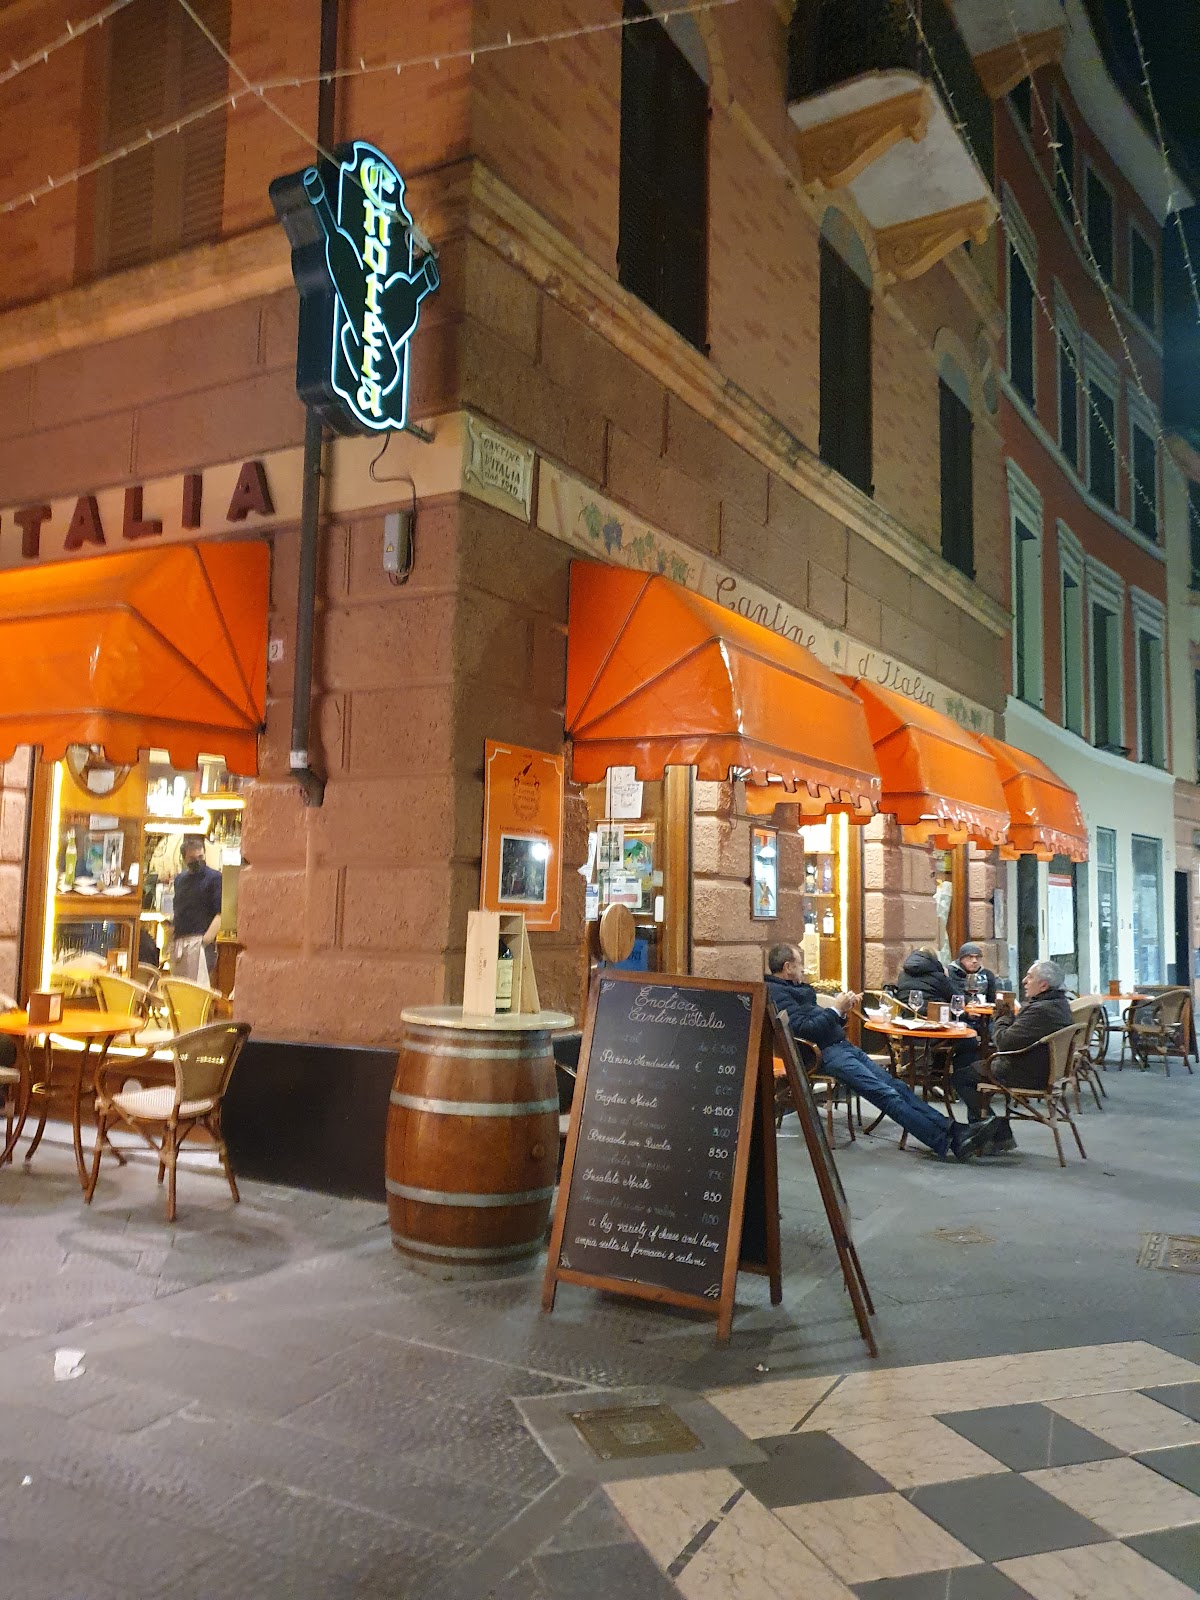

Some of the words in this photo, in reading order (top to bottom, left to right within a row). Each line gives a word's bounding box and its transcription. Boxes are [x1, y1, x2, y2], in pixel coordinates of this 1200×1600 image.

[0, 460, 275, 560] TALIA
[715, 574, 817, 655] Cantine
[634, 985, 699, 1012] Enoteca
[628, 1006, 678, 1025] Cantine
[600, 1049, 632, 1066] Panini
[588, 1216, 597, 1228] a
[599, 1212, 613, 1234] big
[617, 1219, 648, 1240] variety
[648, 1224, 660, 1243] of
[680, 1231, 699, 1246] and
